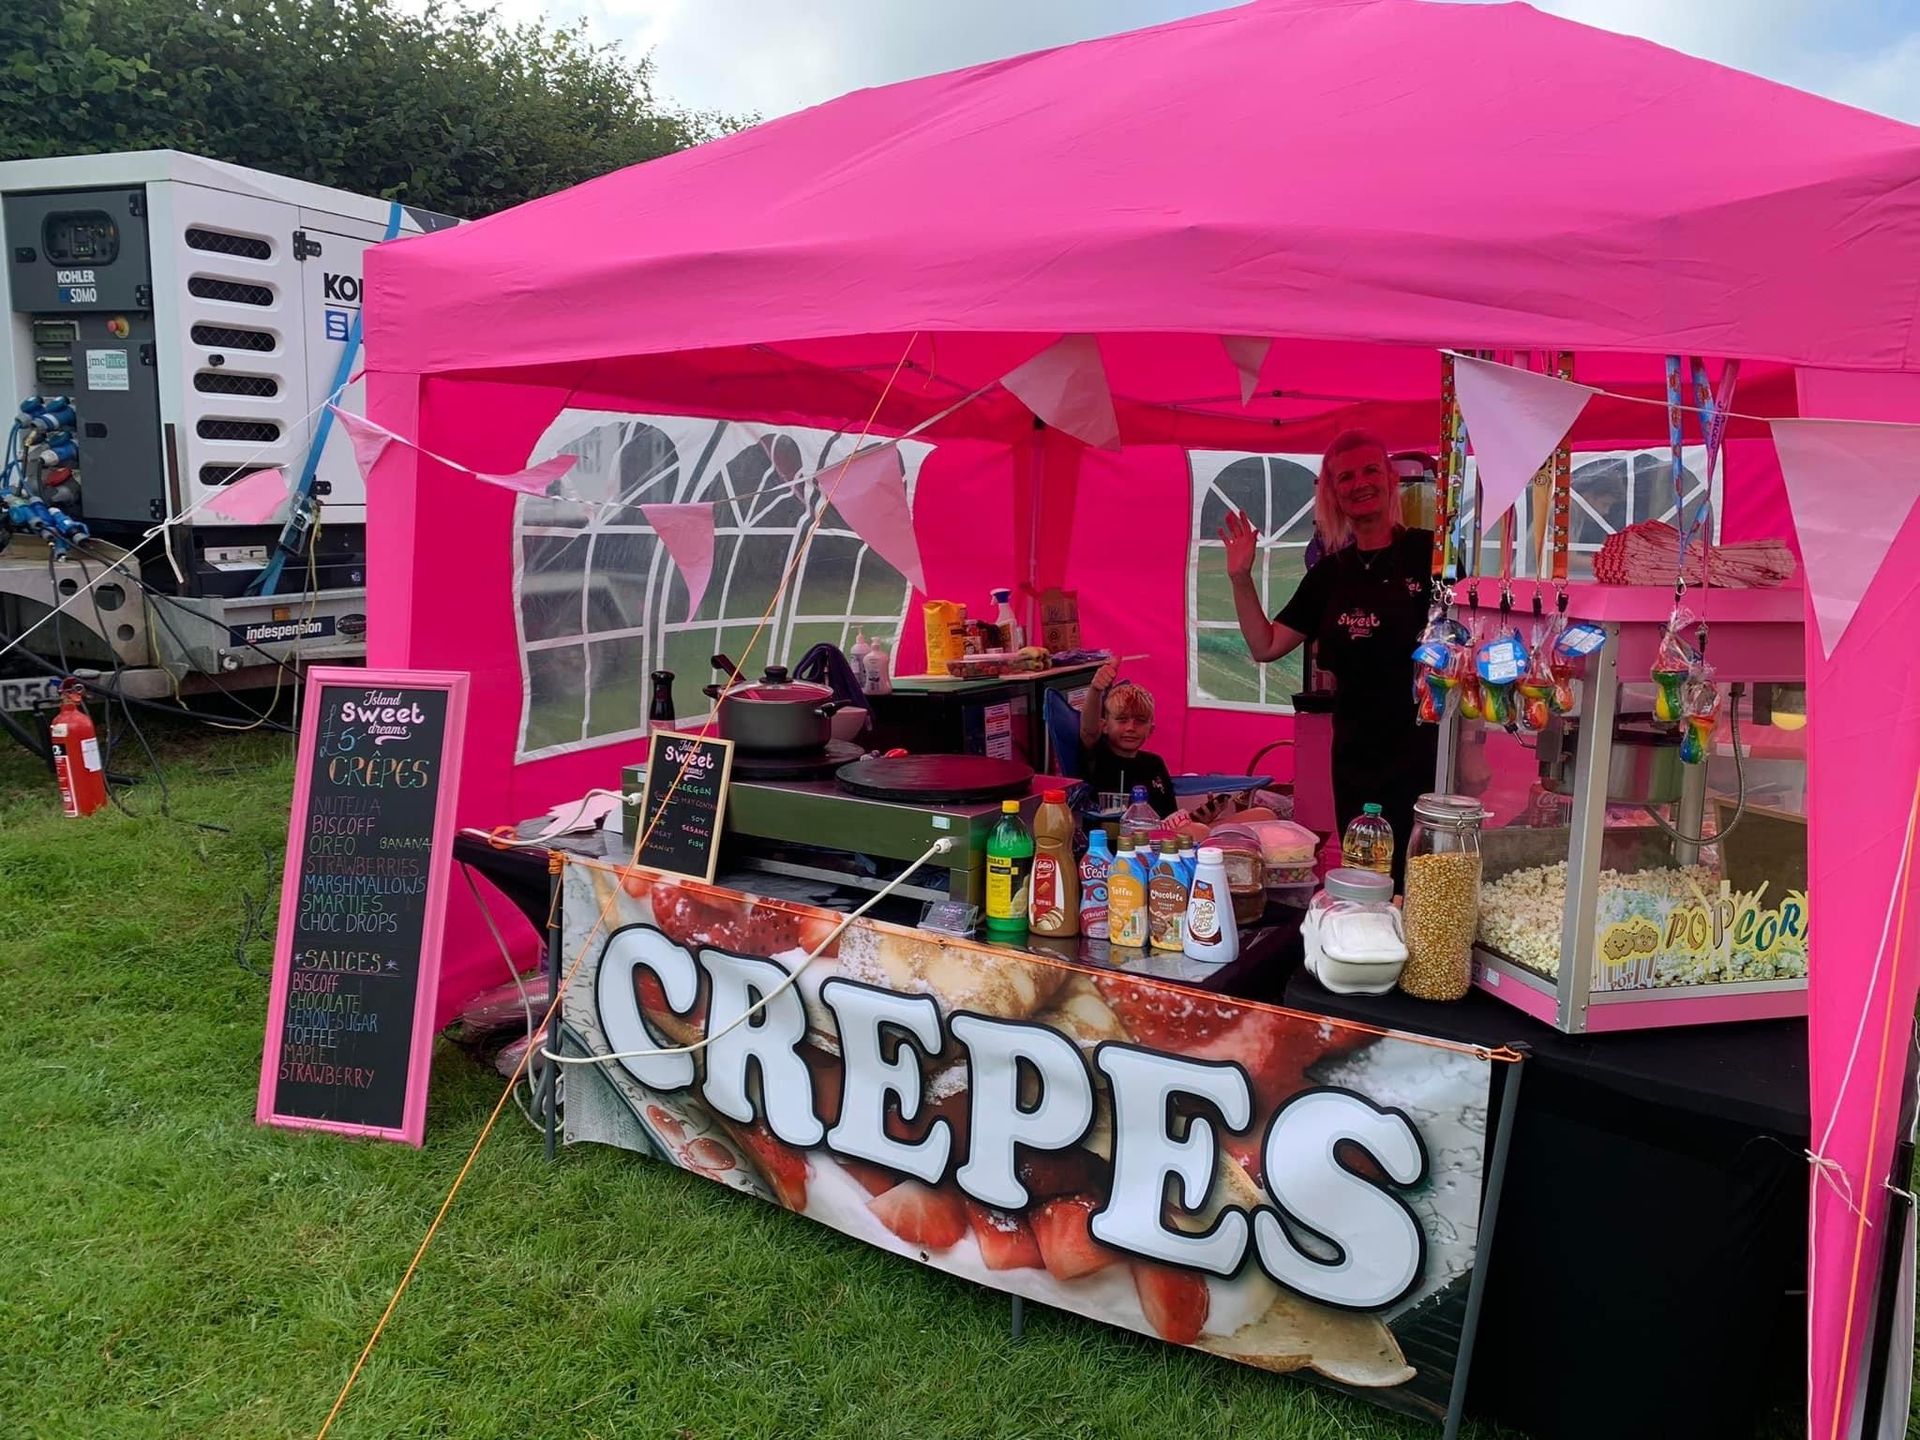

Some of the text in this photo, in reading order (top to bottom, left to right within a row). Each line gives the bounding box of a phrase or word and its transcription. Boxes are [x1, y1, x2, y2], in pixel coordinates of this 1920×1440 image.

[57, 270, 95, 283] KOHLER
[70, 288, 97, 303] SDMO
[363, 690, 402, 706] Island
[341, 702, 425, 724] Sweet
[367, 720, 408, 735] dreams
[665, 746, 714, 769] Sweet
[312, 815, 376, 836] BISCOFF
[309, 835, 356, 856] OREO
[688, 838, 705, 850] FISH
[306, 855, 420, 877] STRAWBERRIES
[303, 874, 427, 896] MARSHMALLOWS
[1111, 886, 1133, 897] Toffee
[1150, 889, 1183, 902] Chocolate
[301, 893, 383, 914] SMARTIES
[300, 912, 398, 933] CHOC DROPS
[292, 973, 340, 992] BISCOFF
[288, 991, 360, 1014] CHOCOLATE
[286, 1024, 338, 1048] TOFFEE
[284, 1044, 329, 1064] MAPLE
[279, 1062, 374, 1089] STRAWBERRY
[597, 923, 1429, 1312] CREPES
